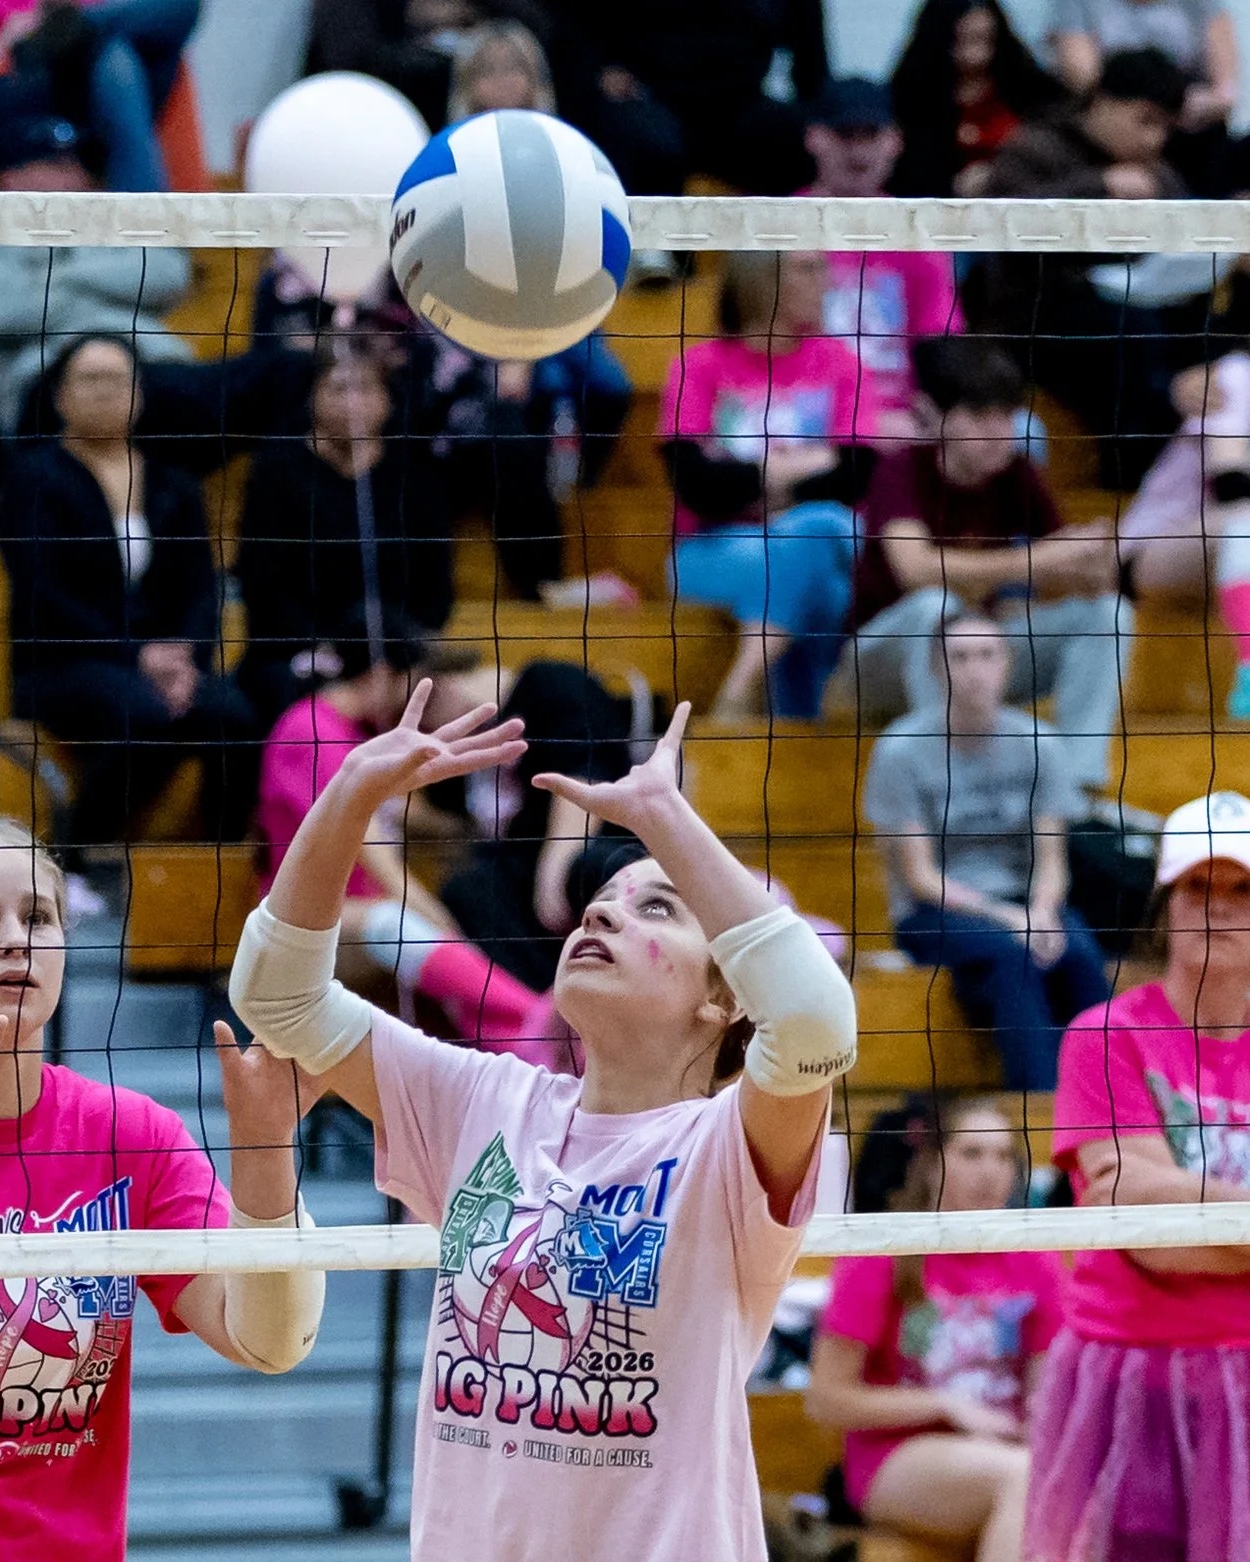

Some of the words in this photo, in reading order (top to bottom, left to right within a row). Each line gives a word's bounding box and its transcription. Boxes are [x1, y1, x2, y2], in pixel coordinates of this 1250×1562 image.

[579, 1157, 677, 1218] MOT
[633, 1231, 657, 1298] CORSAIRS
[588, 1352, 654, 1373] 2026
[435, 1352, 488, 1417] IG
[496, 1363, 659, 1438] PINK
[54, 1443, 76, 1457] FOR
[524, 1440, 563, 1462] UNITED
[565, 1447, 591, 1466] FOR
[593, 1449, 604, 1467] A
[607, 1448, 653, 1468] CAUSE.
